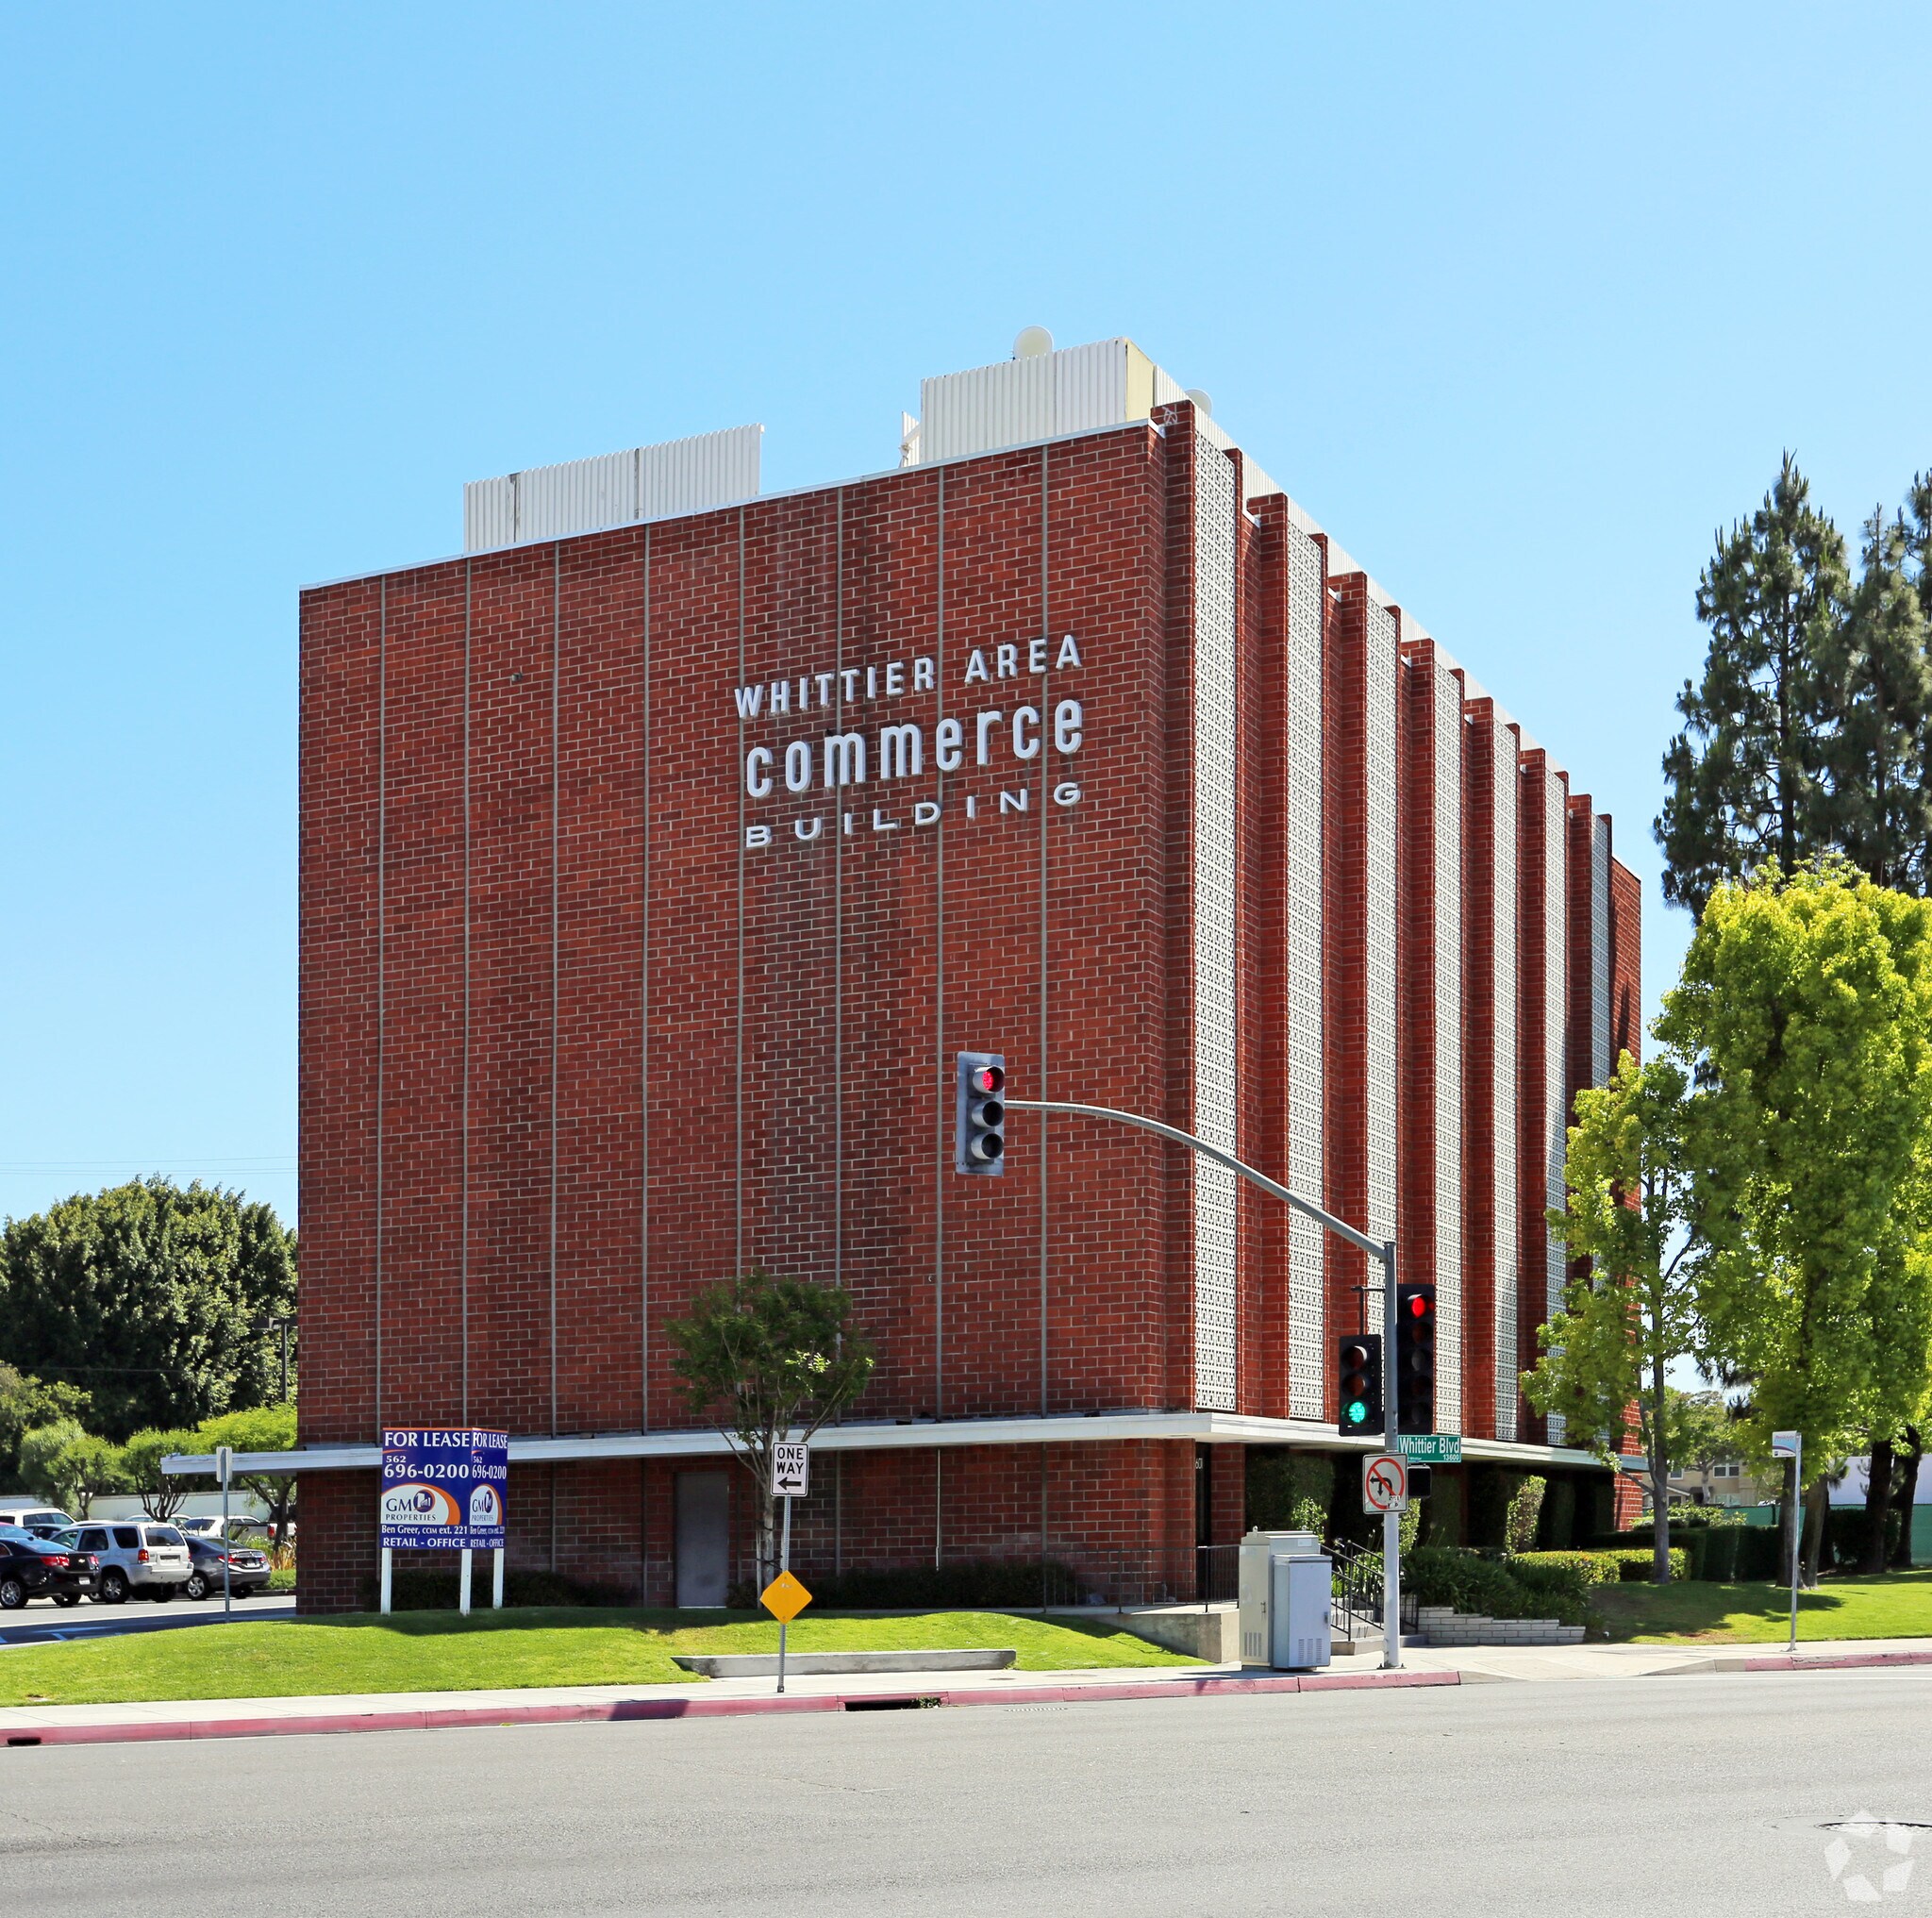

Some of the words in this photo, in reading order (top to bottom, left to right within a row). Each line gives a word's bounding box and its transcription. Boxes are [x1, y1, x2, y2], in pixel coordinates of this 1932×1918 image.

[735, 658, 936, 719] WHITTIER
[964, 634, 1082, 684] AREA
[746, 699, 1083, 798] commerce
[745, 782, 1082, 848] BUILDING
[385, 1432, 418, 1447] FOR
[424, 1432, 470, 1447] LEASE
[473, 1432, 487, 1447] FOR
[489, 1433, 508, 1449] LEASE
[1399, 1437, 1437, 1454] Whittier
[1439, 1437, 1460, 1454] Blvd
[777, 1447, 804, 1459] ONE
[384, 1464, 469, 1478] 696-0200
[472, 1464, 507, 1479] 696-0200
[776, 1461, 804, 1475] WAY
[386, 1498, 412, 1512] GM
[381, 1525, 395, 1534] Ben
[397, 1525, 421, 1535] Greer,
[439, 1526, 452, 1535] ext.
[454, 1526, 468, 1535] 221
[383, 1537, 418, 1547] RETAIL
[427, 1538, 466, 1547] OFFICE
